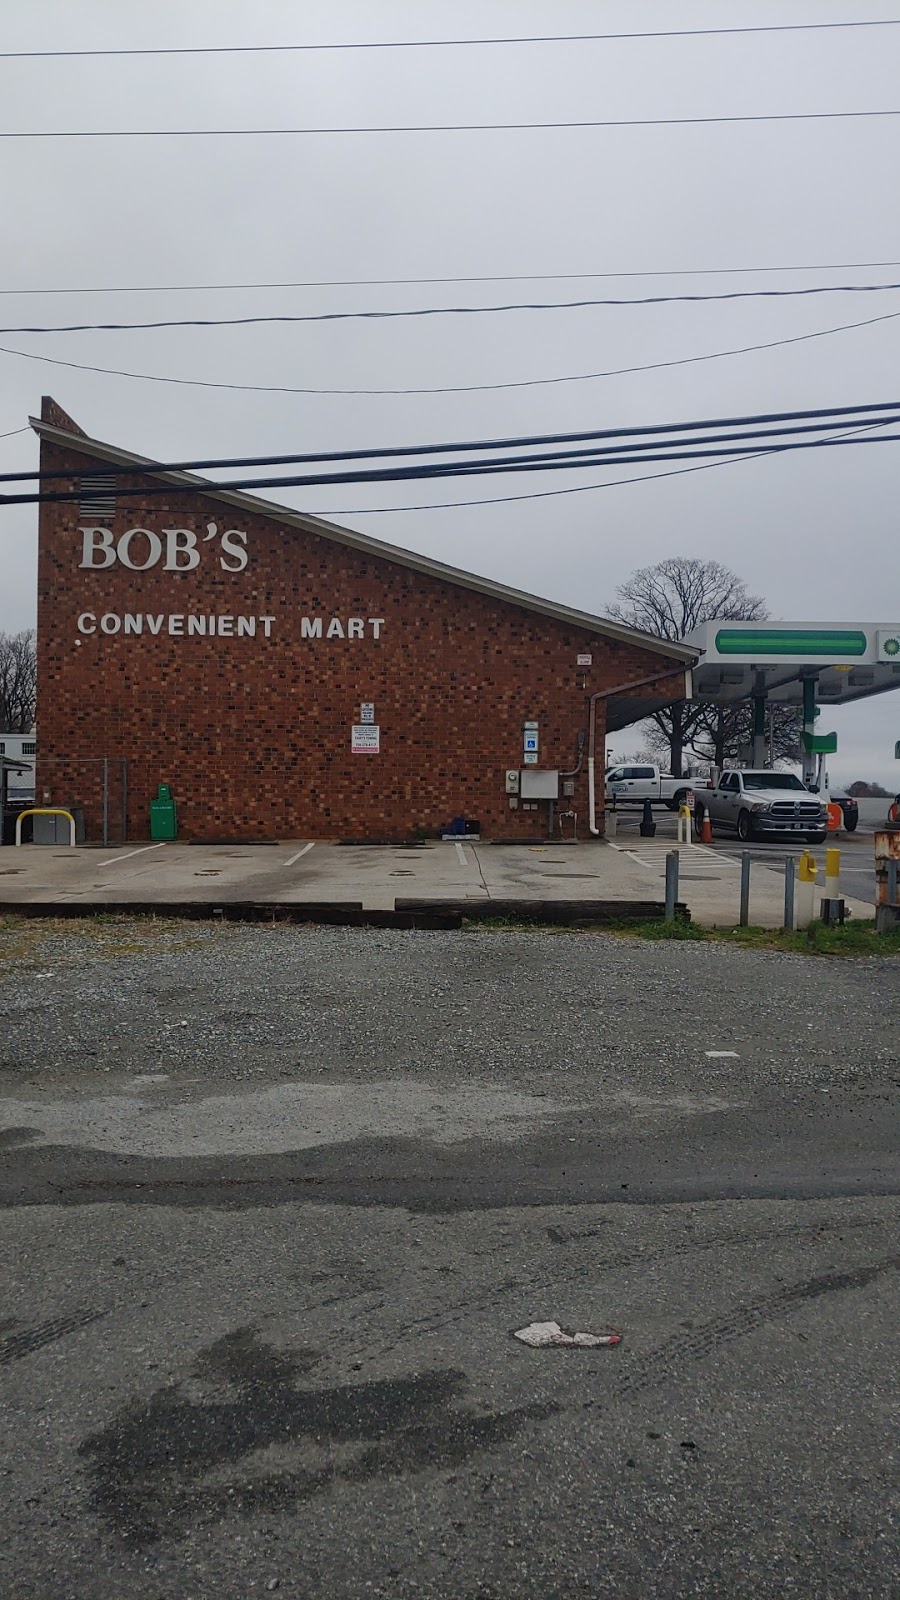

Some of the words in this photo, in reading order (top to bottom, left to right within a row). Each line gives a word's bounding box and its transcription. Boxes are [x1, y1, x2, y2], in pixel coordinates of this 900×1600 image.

[78, 523, 249, 572] BOB'S
[77, 612, 277, 637] CONVENIENT
[301, 616, 386, 639] MART
